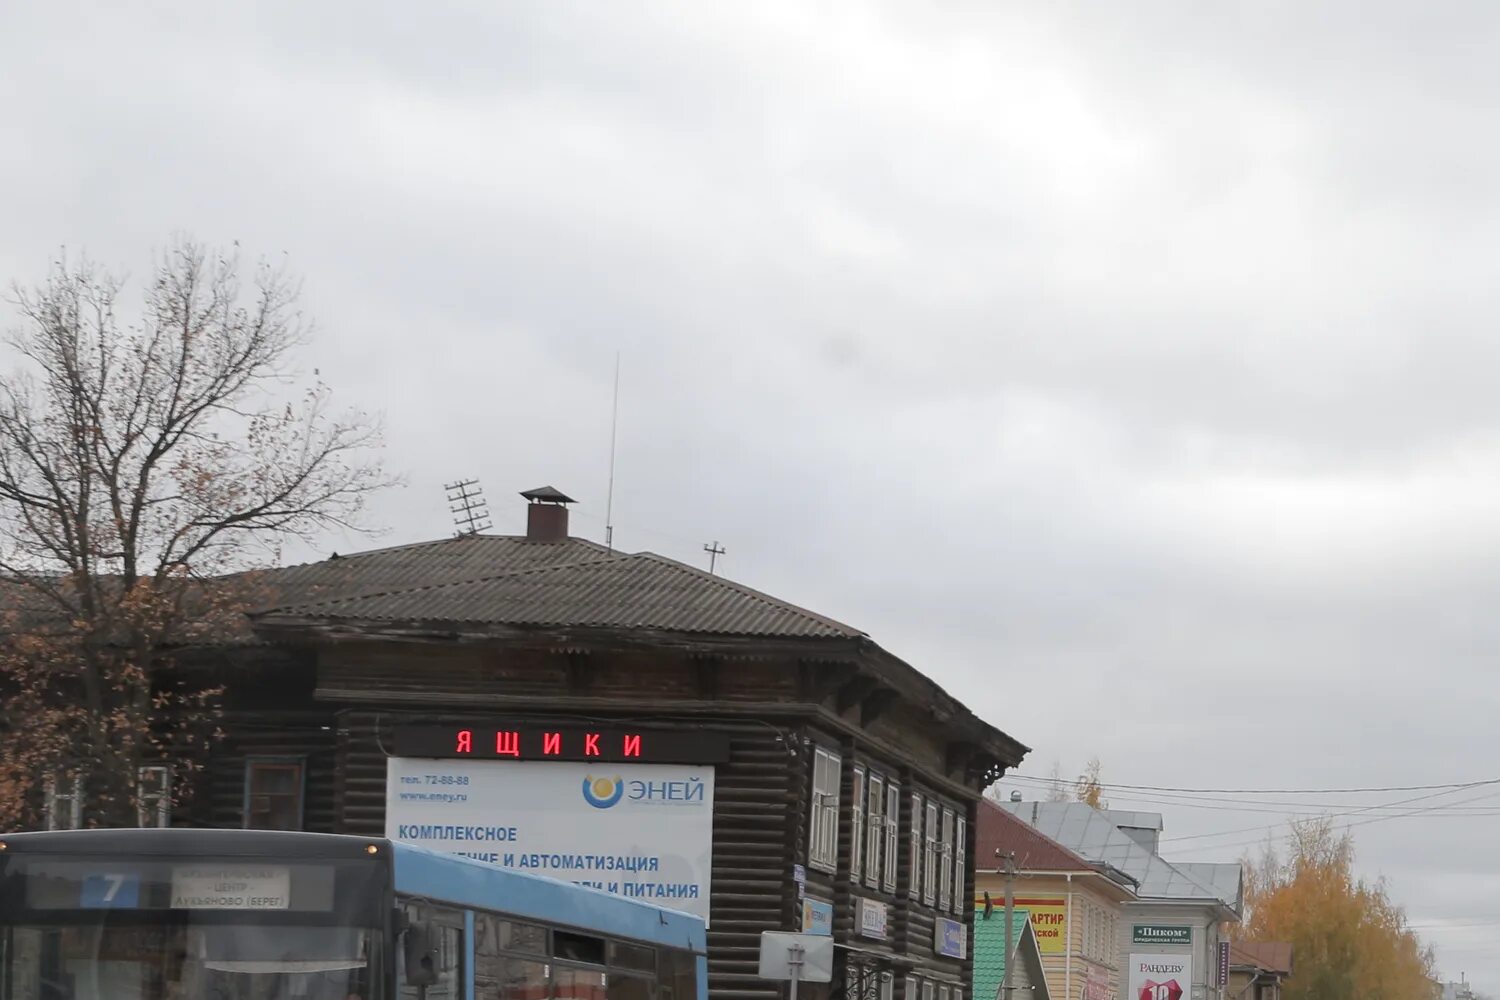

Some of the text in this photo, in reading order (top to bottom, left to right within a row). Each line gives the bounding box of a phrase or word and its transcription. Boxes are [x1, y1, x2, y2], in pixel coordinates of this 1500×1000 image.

[456, 730, 640, 756] ЯЩИКИ
[400, 776, 421, 784] тел.
[628, 777, 704, 800] ЭНЕЙ
[399, 824, 517, 842] КОМПЛЕКСНОЕ
[504, 854, 514, 867] И
[519, 854, 659, 873] АВТОМАТИЗАЦИЯ
[103, 874, 124, 902] 7
[623, 882, 699, 899] ПИТАНИЯ
[1031, 913, 1064, 925] АРТИР
[1035, 928, 1059, 938] ской
[1138, 927, 1187, 937] «Пиком»
[1140, 963, 1184, 974] РАНДЕВУ
